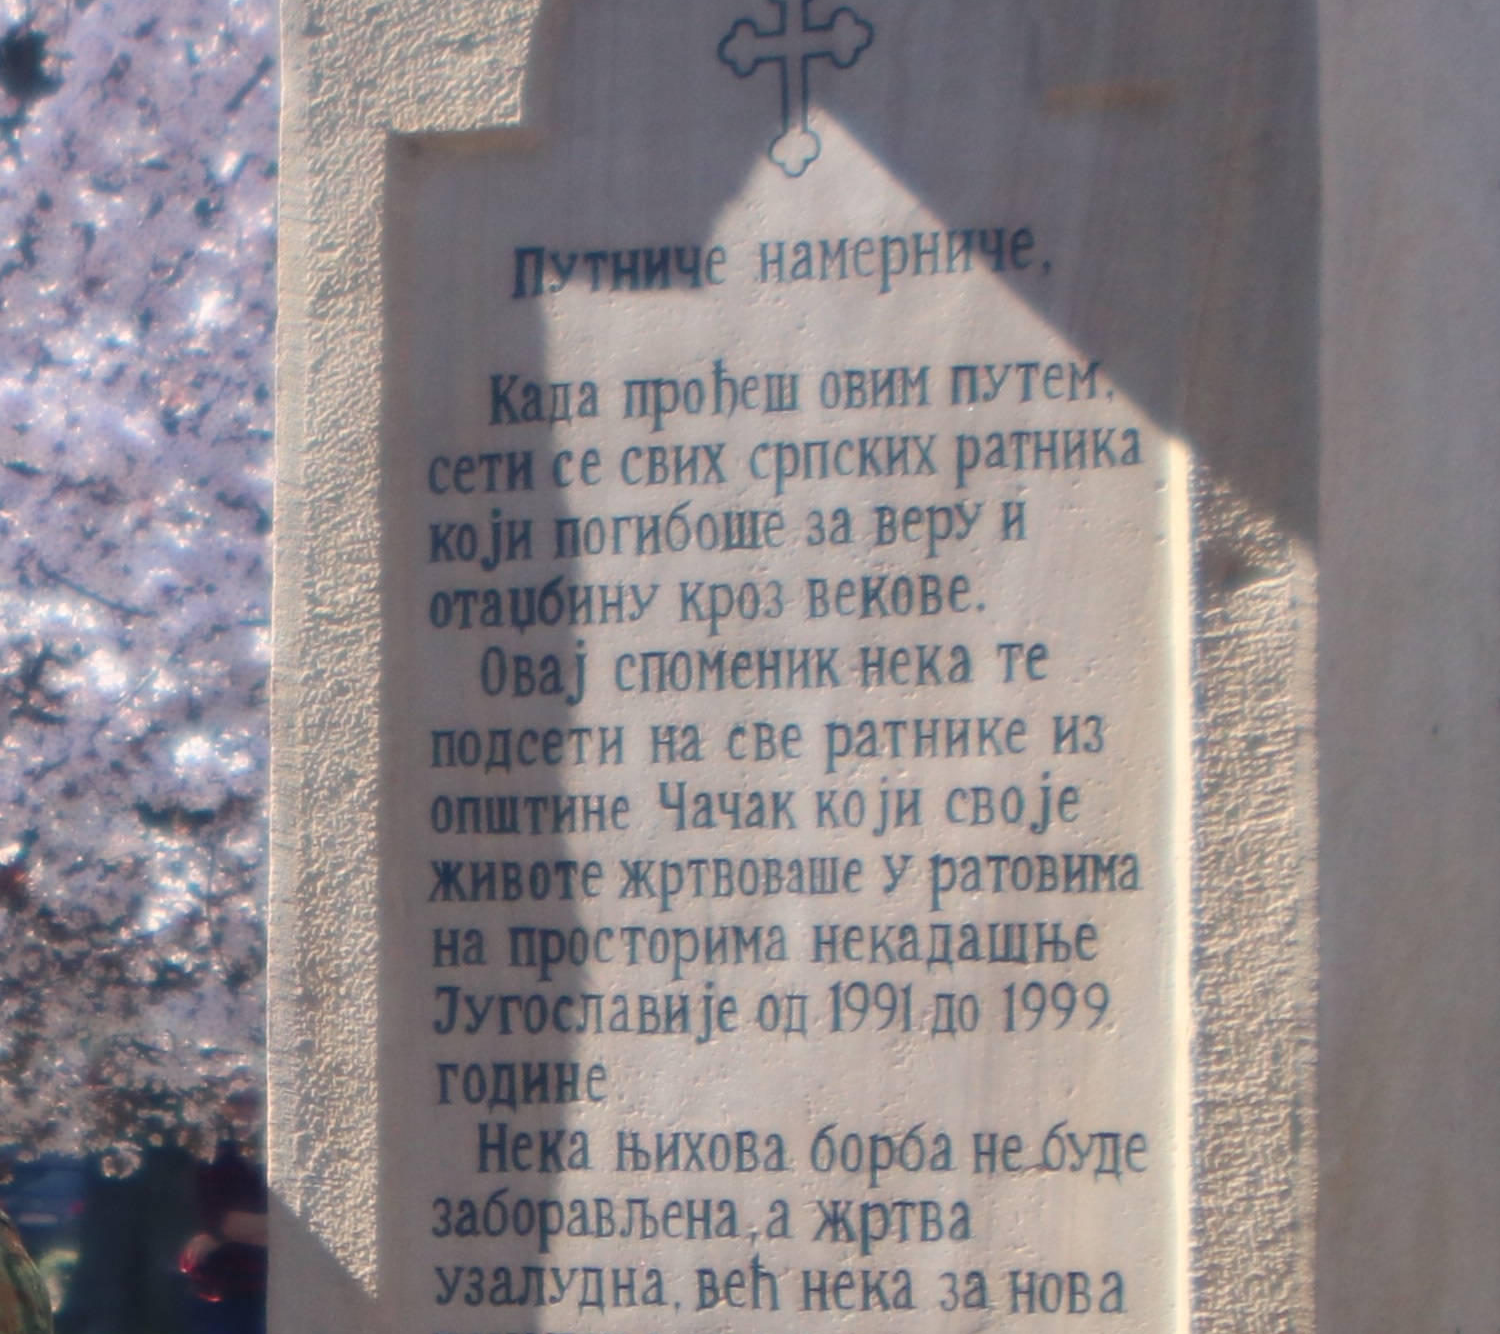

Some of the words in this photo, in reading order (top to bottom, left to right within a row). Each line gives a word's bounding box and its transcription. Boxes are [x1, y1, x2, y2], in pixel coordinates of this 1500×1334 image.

[511, 241, 728, 300] Путниче
[758, 225, 1053, 293] намерниче,
[490, 371, 599, 428] Када
[623, 355, 801, 427] прођеш
[819, 363, 931, 408] овим
[951, 357, 1114, 406] путем,
[427, 448, 535, 495] сети
[551, 446, 602, 487] се
[620, 440, 727, 484] свих
[748, 433, 937, 496] српских
[955, 424, 1143, 482] ратника
[428, 507, 533, 569] који
[554, 500, 787, 557] погибоше
[807, 505, 853, 545] за
[872, 500, 984, 557] веру
[1002, 498, 1028, 540] и
[428, 574, 660, 633] отаџбину
[680, 578, 785, 635] кроз
[806, 572, 987, 618] векове.
[480, 639, 586, 705] Овај
[614, 645, 842, 692] споменик
[860, 642, 974, 686] нека
[996, 639, 1050, 682] те
[430, 724, 625, 773] подсети
[650, 722, 703, 762] на
[727, 719, 803, 760] све
[825, 714, 1028, 774] ратнике
[1053, 712, 1106, 753] из
[430, 791, 631, 834] општине
[659, 779, 798, 830] Чачак
[815, 768, 923, 836] који
[946, 768, 1081, 834] своје
[430, 857, 604, 900] животе
[620, 855, 864, 912] жртвоваше
[882, 852, 914, 894] у
[930, 851, 1142, 911] ратовима
[432, 926, 485, 967] на
[509, 923, 788, 989] просторима
[812, 920, 1098, 971] некадашње
[432, 982, 739, 1045] Југославије
[756, 991, 809, 1039] од
[932, 990, 981, 1038] до
[478, 1120, 590, 1172] Нека
[616, 1127, 788, 1172] њихова
[810, 1122, 954, 1183] борба
[973, 1130, 1025, 1173] не
[1040, 1120, 1149, 1184] буде
[815, 1197, 974, 1255] жртва
[434, 1265, 681, 1315] узалудна,
[697, 1252, 781, 1311] већ
[803, 1267, 916, 1310] нека
[940, 1268, 992, 1310] за
[1010, 1267, 1127, 1314] нова
